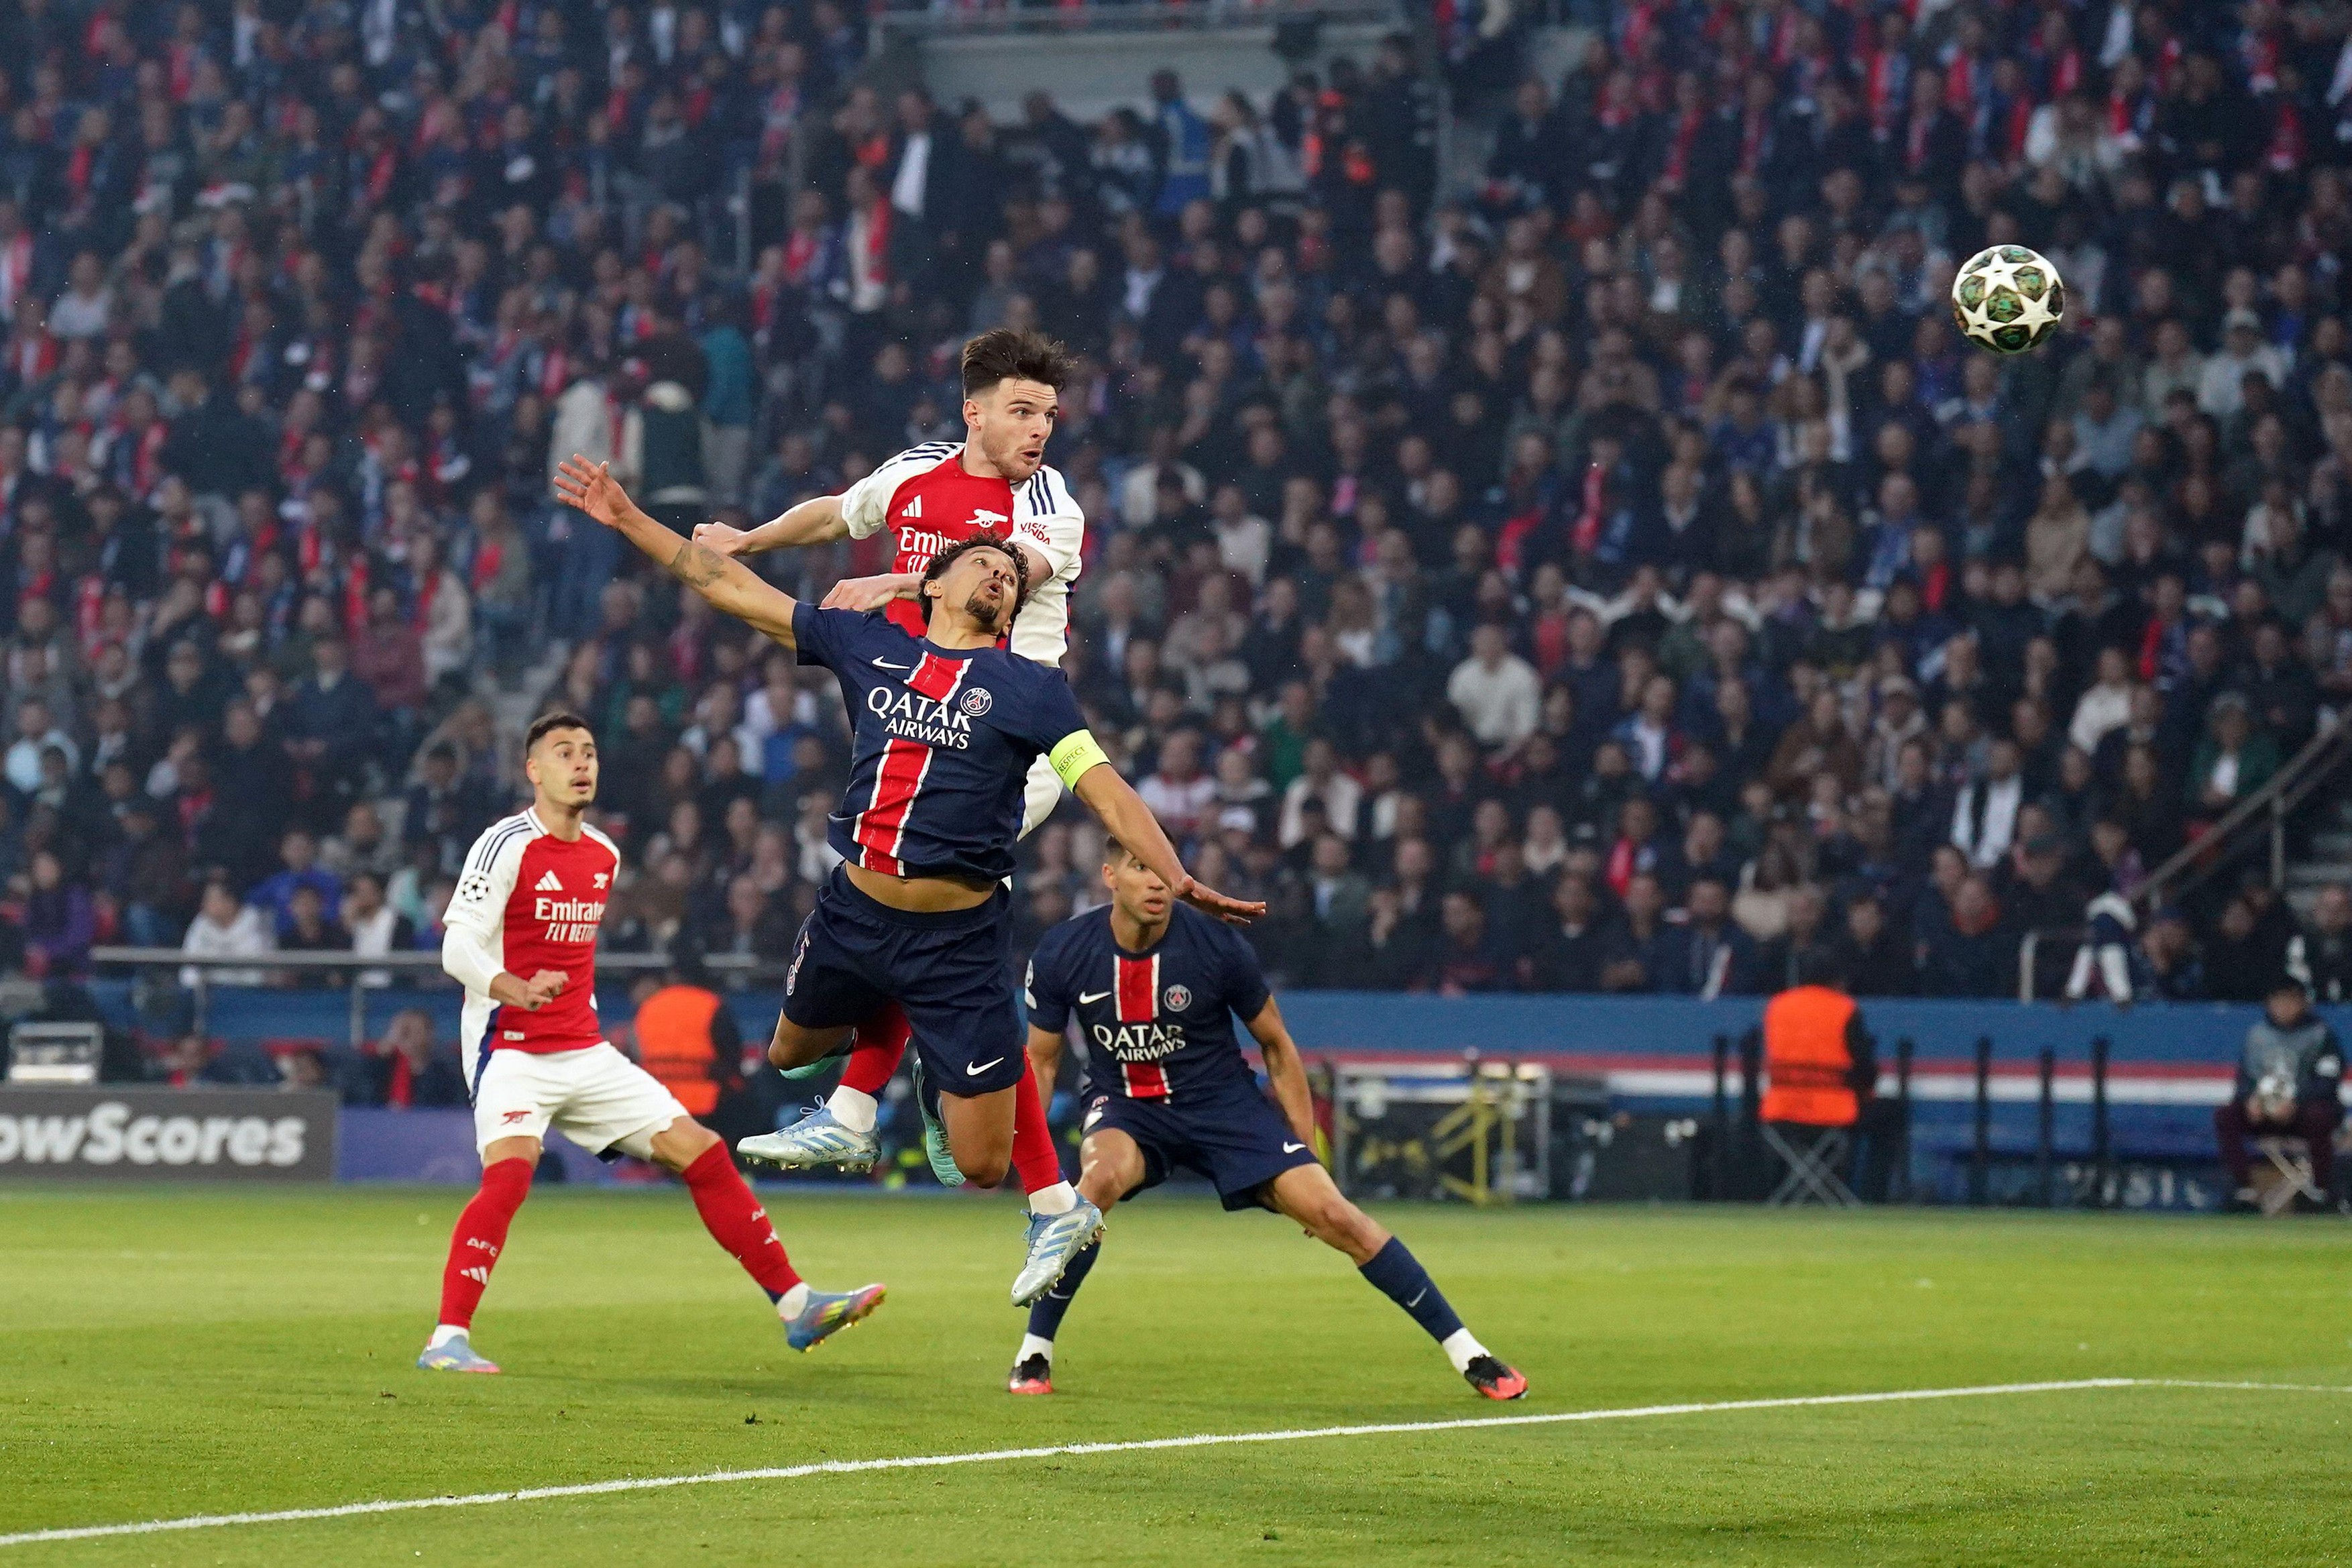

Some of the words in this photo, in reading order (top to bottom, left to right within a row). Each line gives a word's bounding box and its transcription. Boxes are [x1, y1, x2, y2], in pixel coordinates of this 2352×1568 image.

[900, 526, 970, 555] Emir
[885, 717, 970, 750] AIRWAYS
[1058, 746, 1086, 773] RESPECT
[545, 922, 568, 942] FLY
[1115, 1038, 1186, 1062] AIRWAYS
[466, 1237, 498, 1257] AFC
